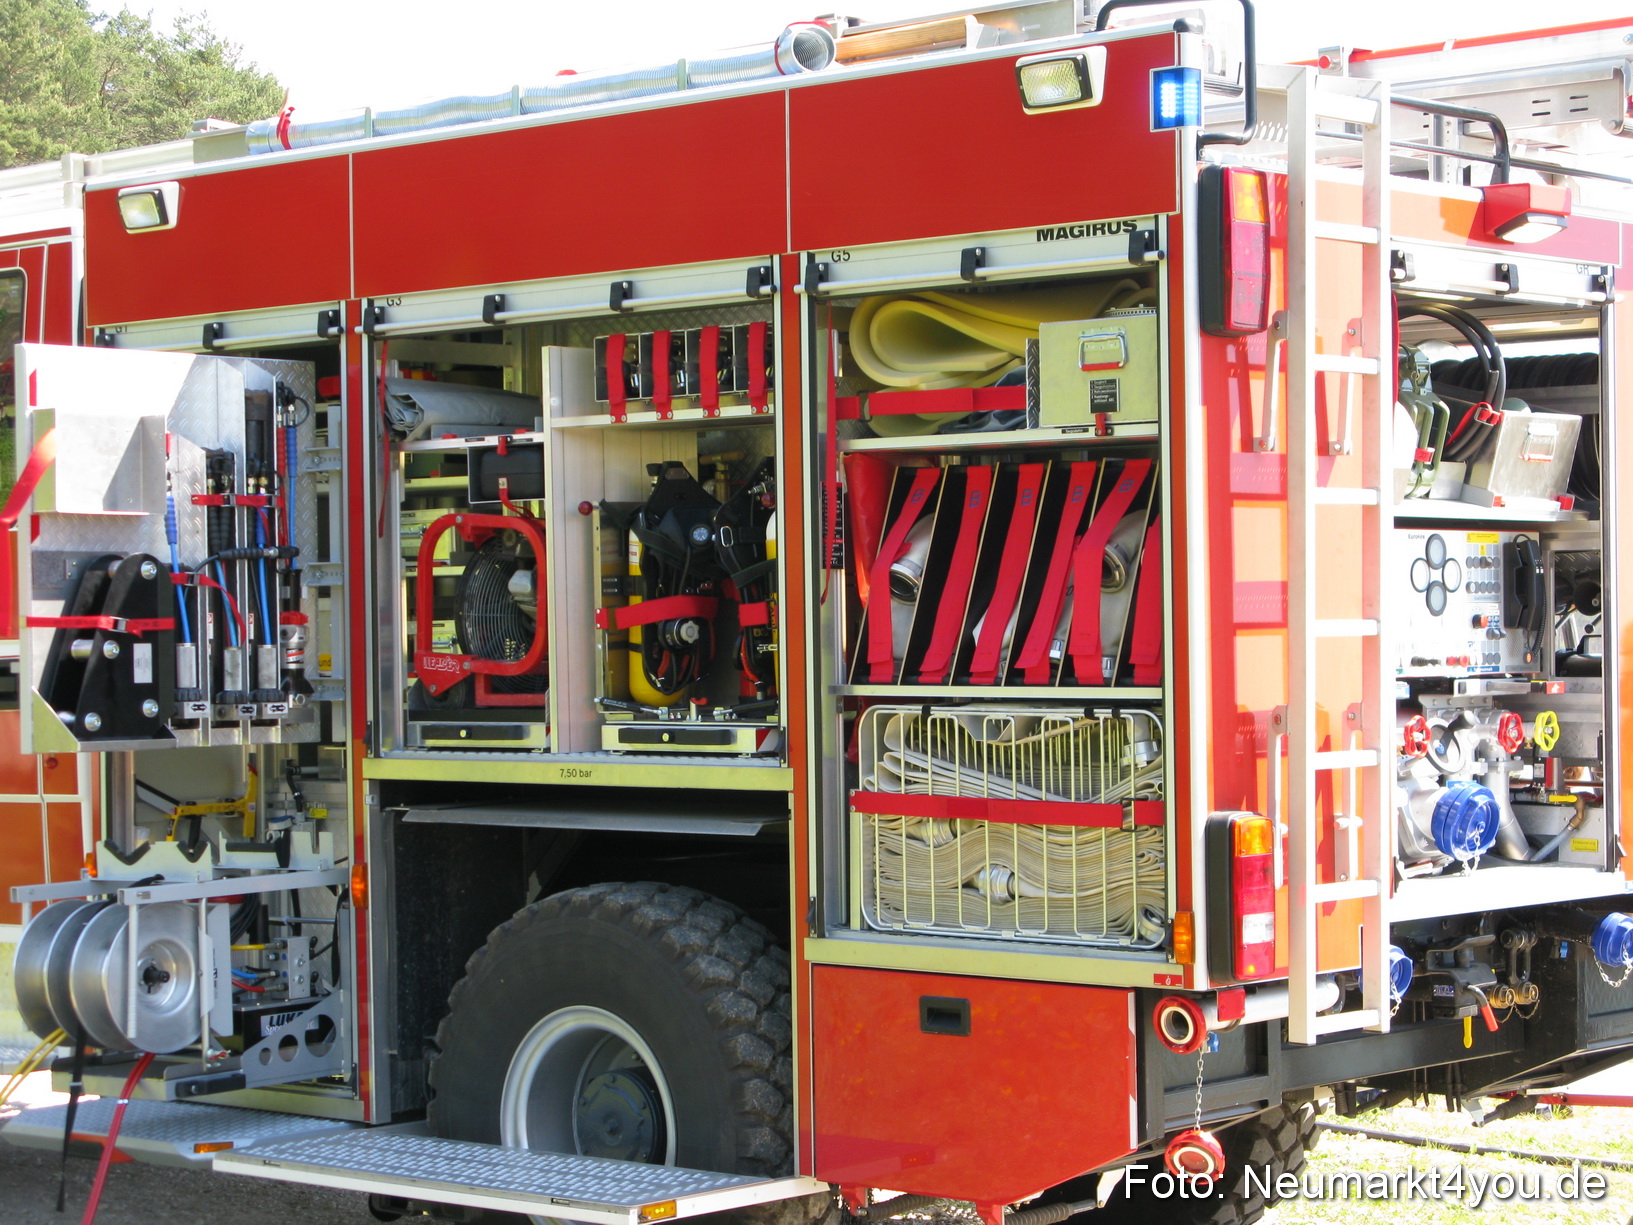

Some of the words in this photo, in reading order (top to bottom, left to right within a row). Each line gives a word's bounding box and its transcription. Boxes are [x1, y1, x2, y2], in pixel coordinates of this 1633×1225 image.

[1036, 219, 1138, 242] MAGIRUS
[831, 249, 851, 263] G5
[386, 296, 402, 307] G3
[559, 768, 578, 779] 7,50
[579, 768, 593, 778] bar
